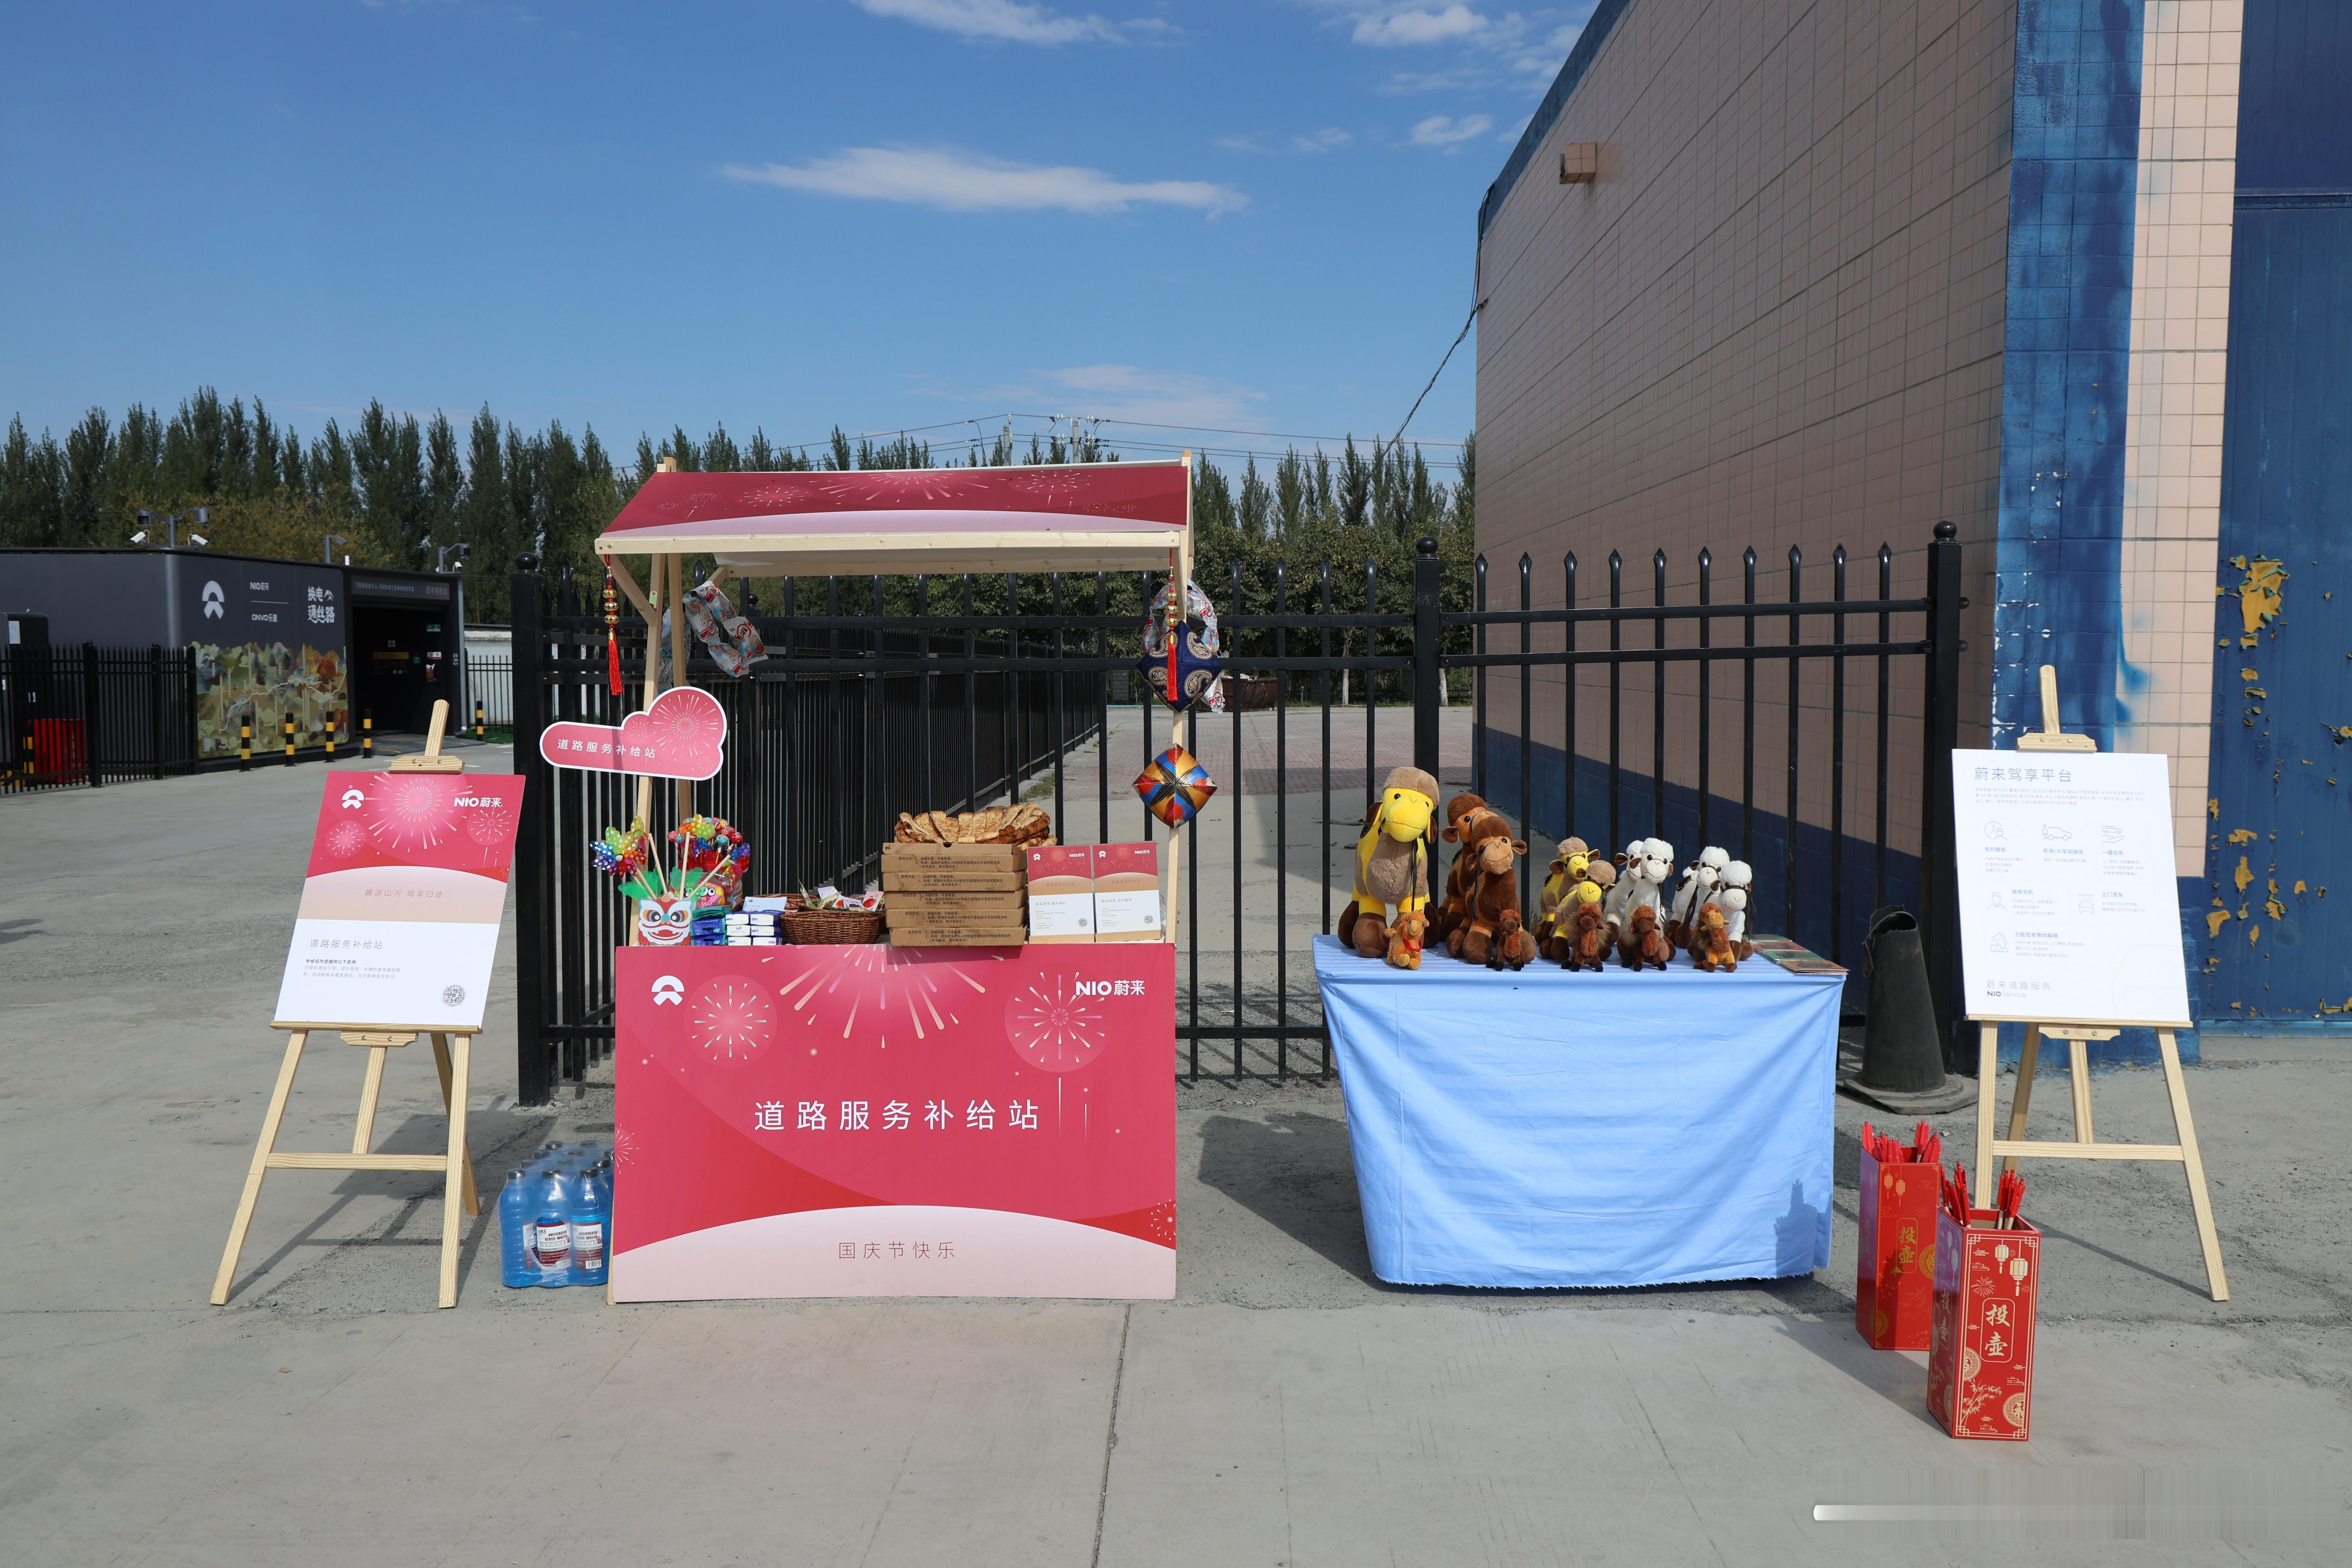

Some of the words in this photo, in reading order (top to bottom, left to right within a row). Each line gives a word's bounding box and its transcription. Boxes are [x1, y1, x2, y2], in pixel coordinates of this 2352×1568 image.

[308, 586, 323, 602] 换电
[307, 605, 335, 624] 通丝路
[557, 739, 656, 759] 道路服务补给站
[1975, 767, 2071, 782] 蔚来驾享平台
[364, 889, 402, 897] 趣游山河
[407, 890, 443, 898] 驾享归途
[309, 939, 383, 950] 道路服务补给站
[1076, 980, 1145, 996] NIO蔚来
[1986, 980, 2052, 991] 蔚来道路服务
[754, 1099, 1040, 1131] 道路服务补给站
[838, 1240, 956, 1260] 国庆节快乐
[1898, 1226, 1917, 1264] 投壶
[1985, 1304, 2011, 1357] 投壶
